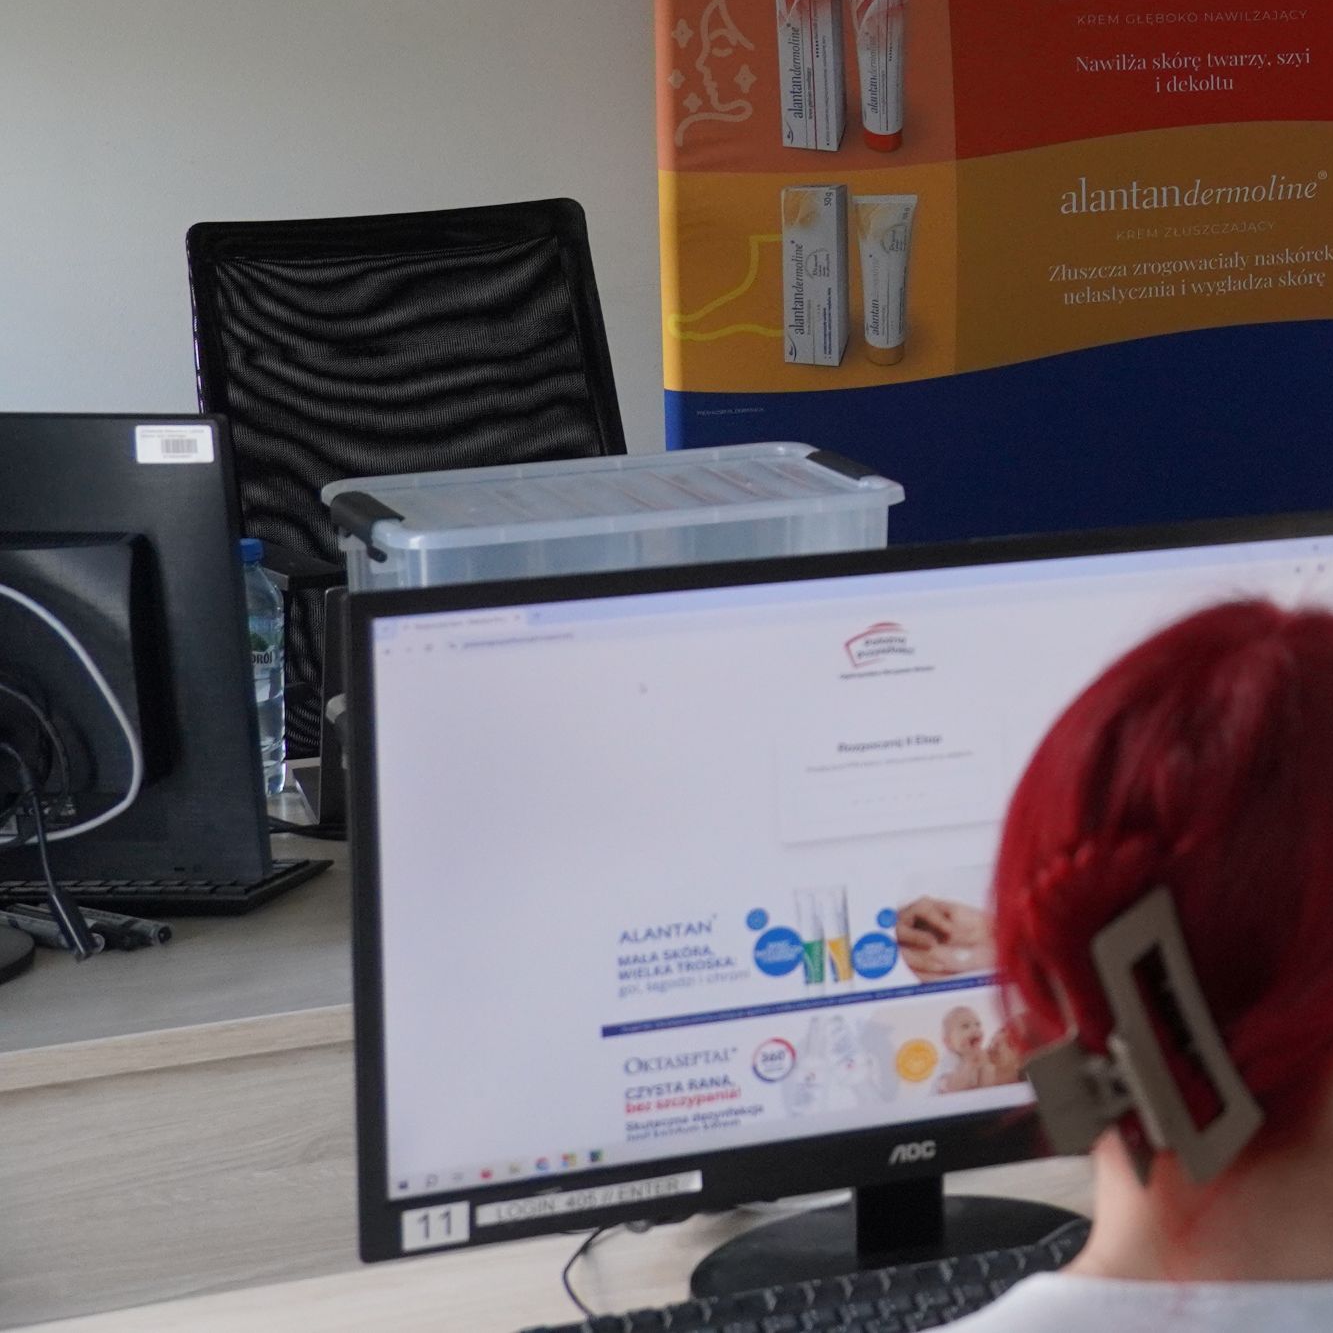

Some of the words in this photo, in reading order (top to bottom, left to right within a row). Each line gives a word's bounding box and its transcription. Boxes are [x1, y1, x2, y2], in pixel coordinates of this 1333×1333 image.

[1077, 13, 1120, 27] KREM
[1075, 52, 1147, 74] Nawilża
[1151, 50, 1202, 73] skórę
[1206, 50, 1273, 71] twarzy,
[1276, 47, 1312, 68] szyi
[1155, 75, 1162, 93] i
[1047, 263, 1128, 283] Złuszcza
[1132, 250, 1248, 277] zrogowaciały
[1062, 280, 1176, 307] uelastycznia
[1180, 279, 1187, 296] i
[1190, 272, 1273, 298] wygładza
[1276, 269, 1328, 290] skórę
[416, 1209, 454, 1241] 11
